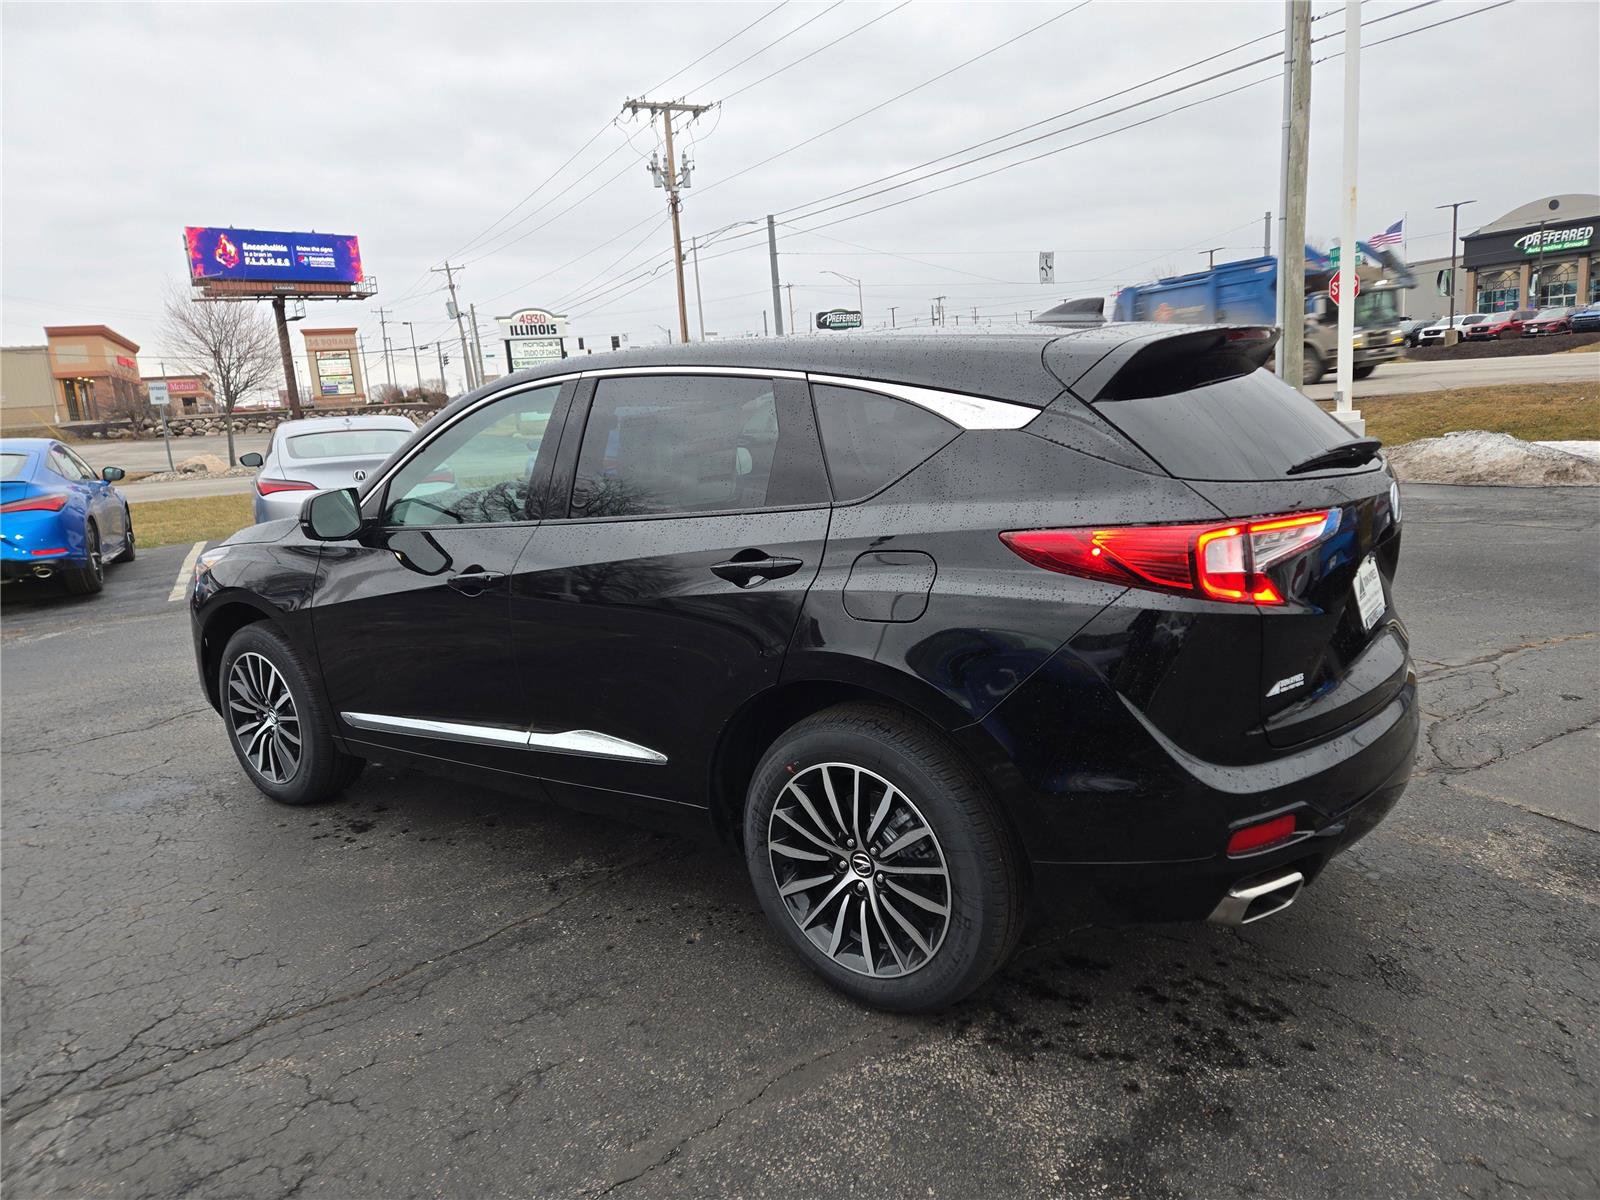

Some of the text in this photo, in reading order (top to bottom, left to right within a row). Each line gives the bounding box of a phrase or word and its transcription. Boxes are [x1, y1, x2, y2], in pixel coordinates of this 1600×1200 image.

[1516, 226, 1594, 250] PREFERRED
[519, 314, 546, 324] 4930
[821, 313, 861, 326] PREFERRED
[510, 324, 557, 336] ILLINOIS
[170, 383, 196, 391] Mobile
